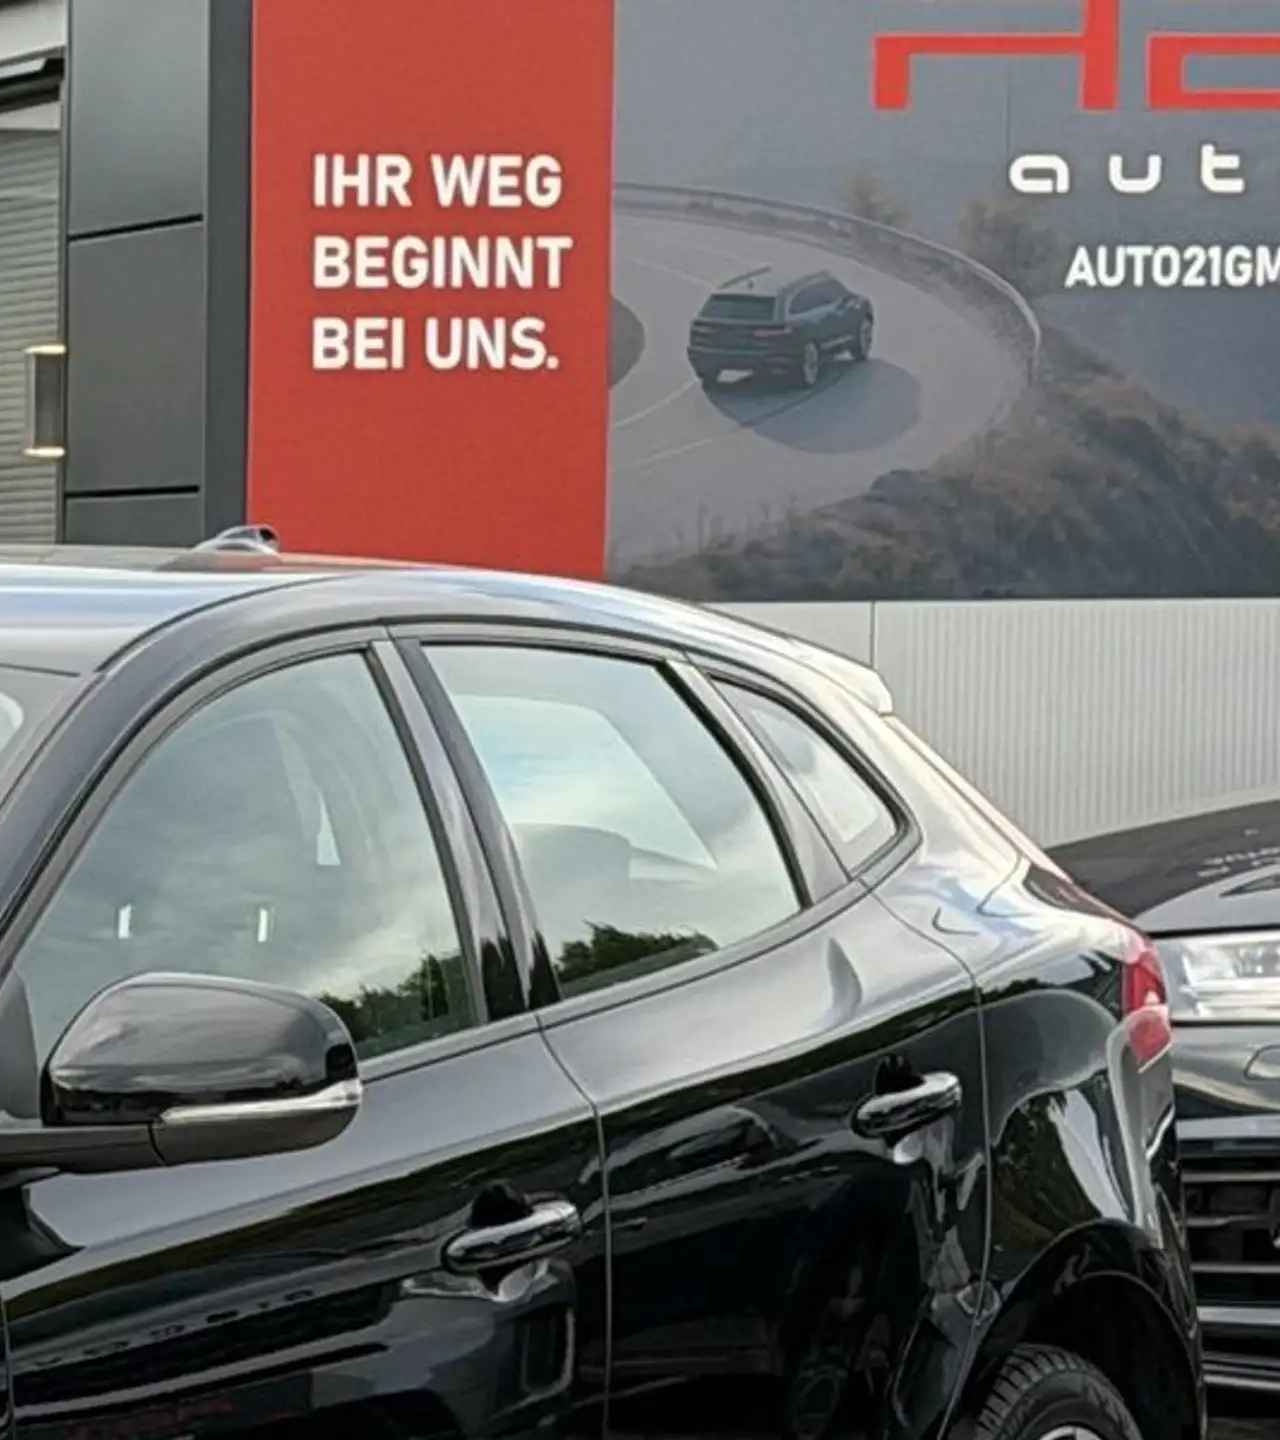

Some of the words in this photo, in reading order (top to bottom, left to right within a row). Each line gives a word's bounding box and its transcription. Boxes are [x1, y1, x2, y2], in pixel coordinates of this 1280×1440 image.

[313, 153, 412, 208] IHR
[430, 153, 562, 208] WEG
[313, 235, 573, 289] BEGINNT
[312, 317, 405, 370] BEI
[425, 317, 560, 370] UNS.
